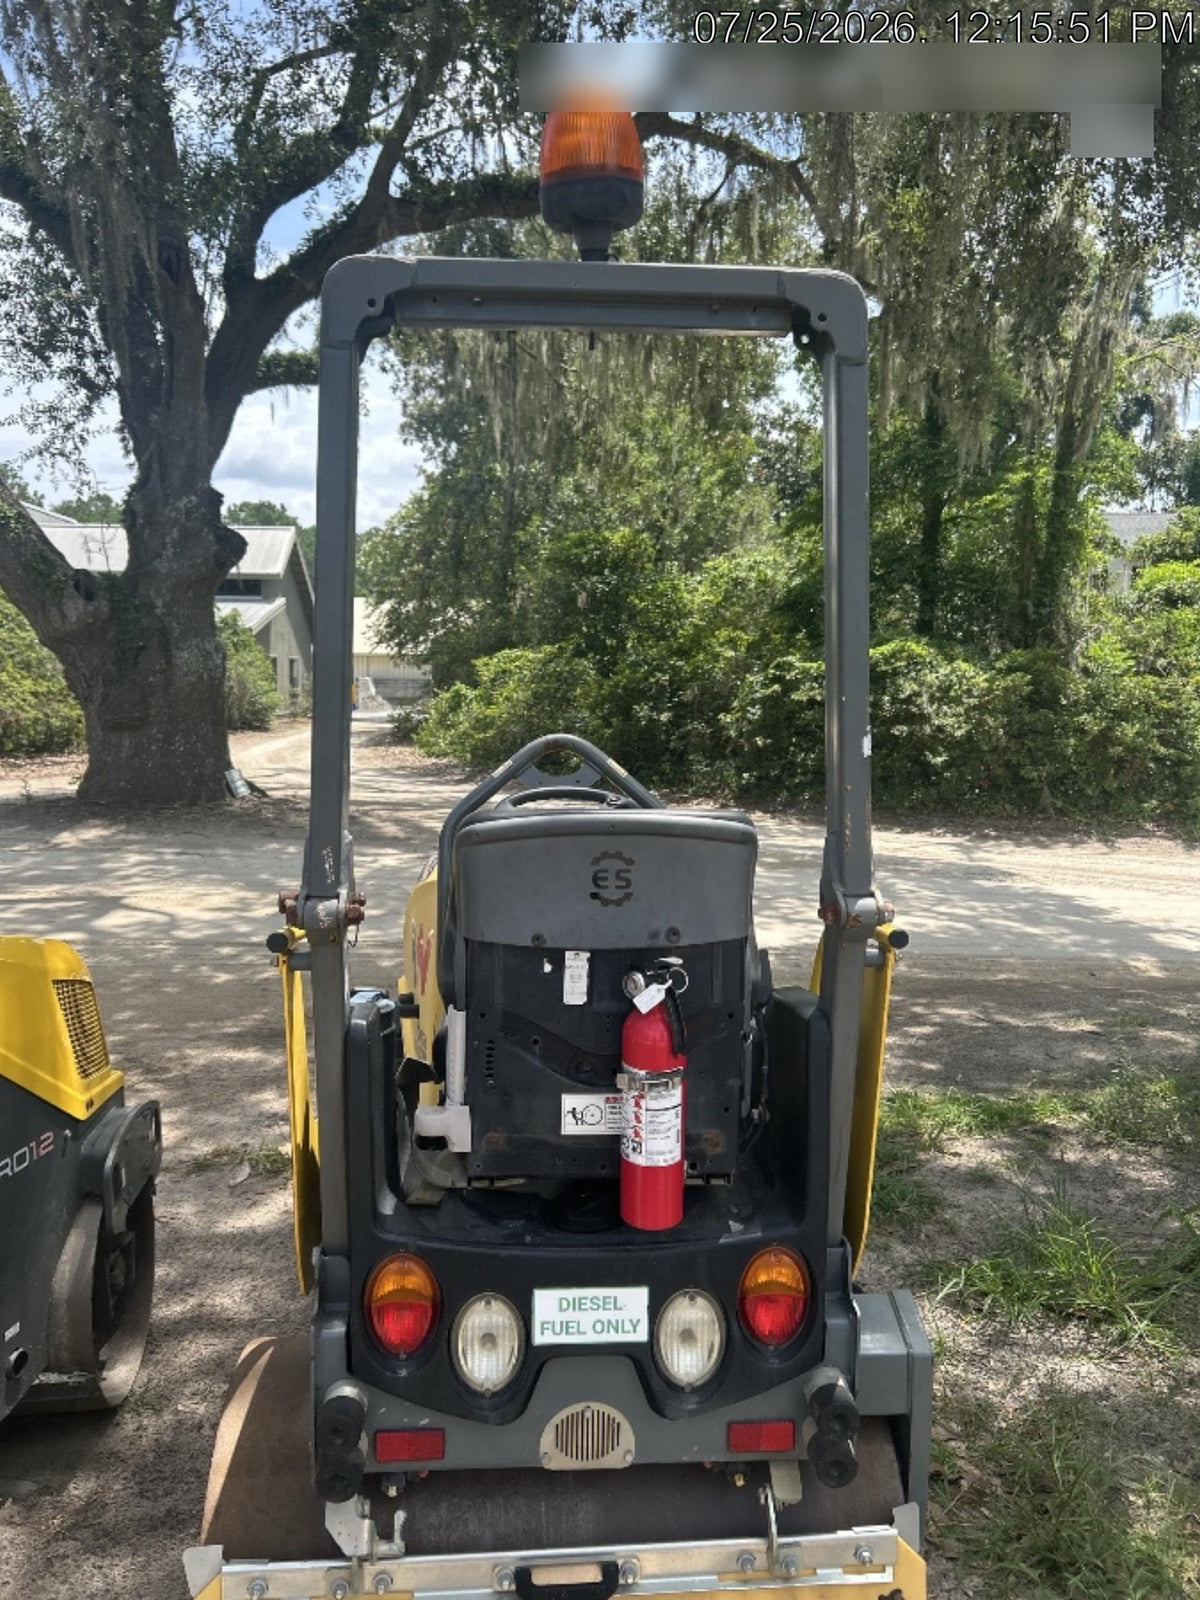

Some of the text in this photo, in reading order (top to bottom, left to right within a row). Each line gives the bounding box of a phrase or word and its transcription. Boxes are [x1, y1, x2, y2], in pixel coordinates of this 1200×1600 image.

[558, 1295, 624, 1313] DIESEL
[540, 1318, 641, 1336] FUEL ONLY
